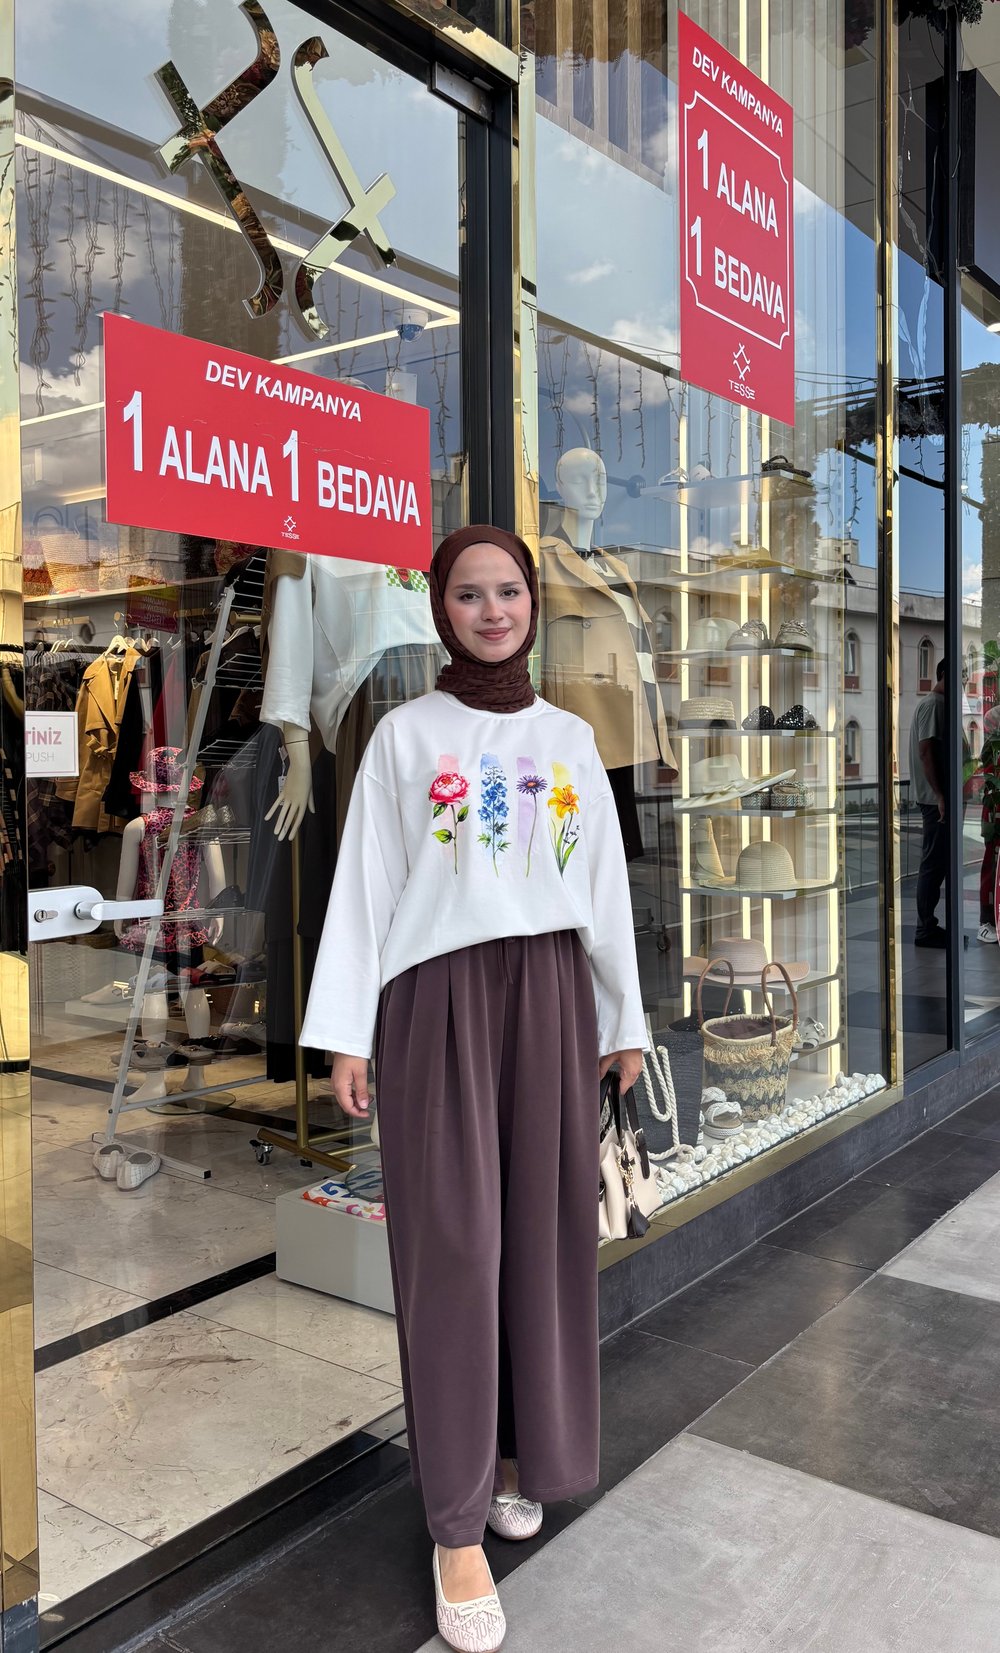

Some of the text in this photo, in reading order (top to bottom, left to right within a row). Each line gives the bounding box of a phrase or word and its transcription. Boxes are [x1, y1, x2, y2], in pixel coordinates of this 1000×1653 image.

[692, 46, 783, 138] DEV KAMPANYA
[697, 128, 779, 238] 1 ALANA
[690, 215, 785, 324] 1 BEDAVA
[205, 360, 362, 422] DEV KAMPANYA
[728, 379, 756, 400] TESSE
[123, 390, 421, 526] 1 ALANA 1 BEDAVA
